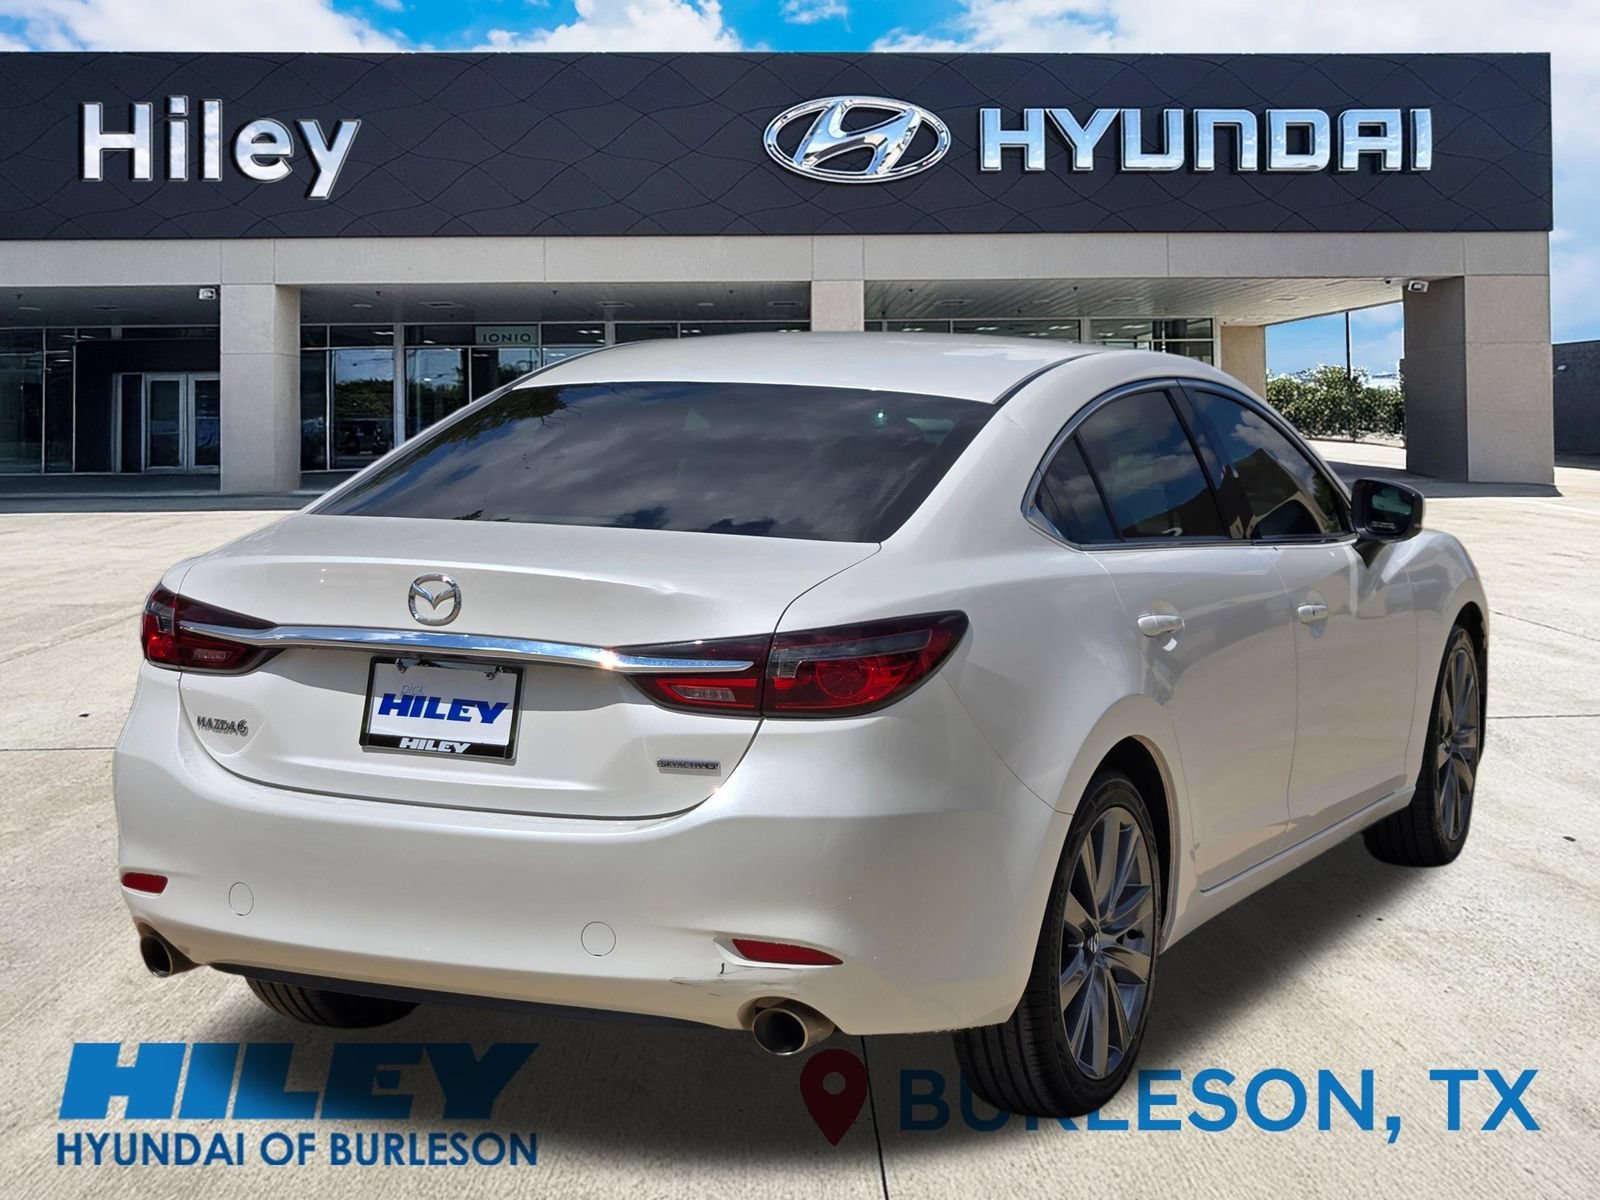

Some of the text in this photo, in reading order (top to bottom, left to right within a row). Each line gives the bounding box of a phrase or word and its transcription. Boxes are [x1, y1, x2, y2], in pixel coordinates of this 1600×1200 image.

[81, 95, 362, 199] Hiley
[979, 107, 1434, 173] HYUNDAI
[483, 333, 531, 342] IONIQ
[378, 693, 509, 724] HILEY
[399, 737, 471, 753] HILEY
